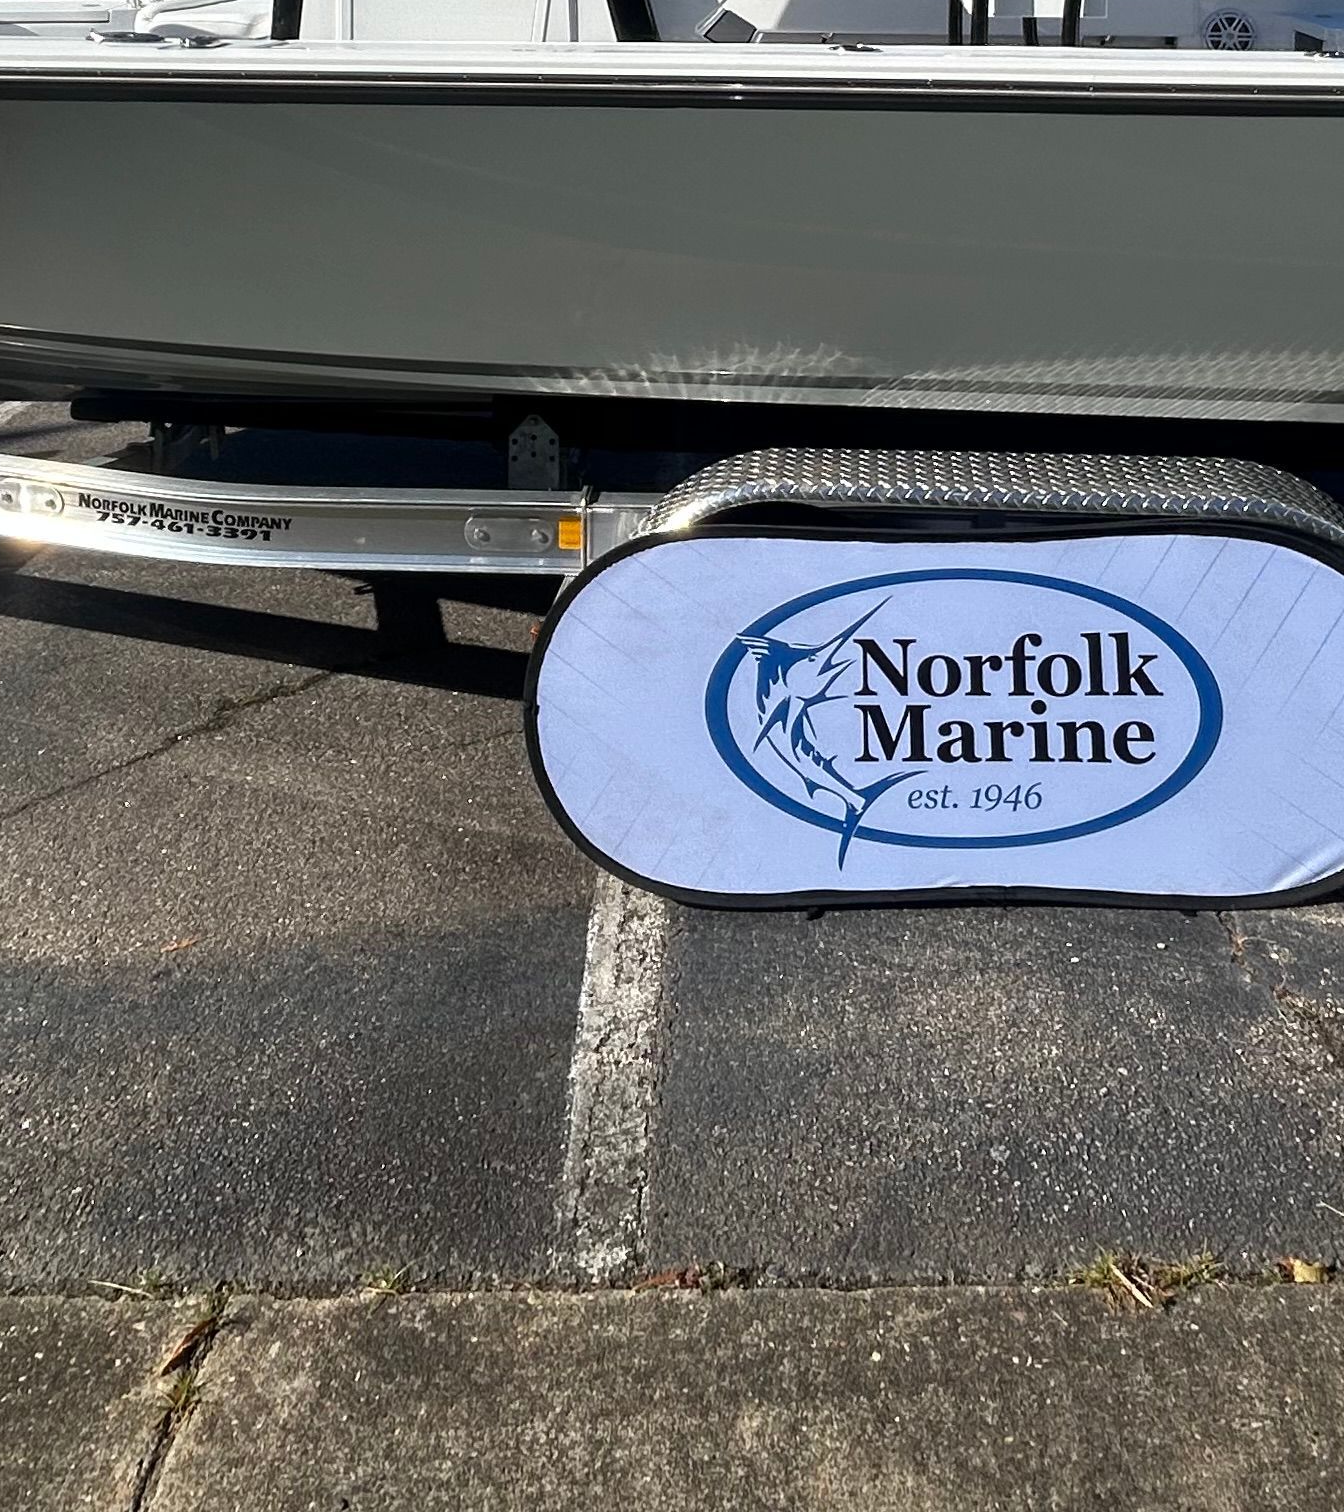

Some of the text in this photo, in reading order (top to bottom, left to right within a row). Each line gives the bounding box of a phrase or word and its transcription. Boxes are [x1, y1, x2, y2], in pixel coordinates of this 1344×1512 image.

[78, 492, 292, 530] NORFOLK MARINE COMPANY
[96, 510, 271, 541] 757-461-3391
[853, 632, 1164, 697] Norfolk
[854, 699, 1156, 765] Marine
[907, 782, 1043, 812] est. 1946
